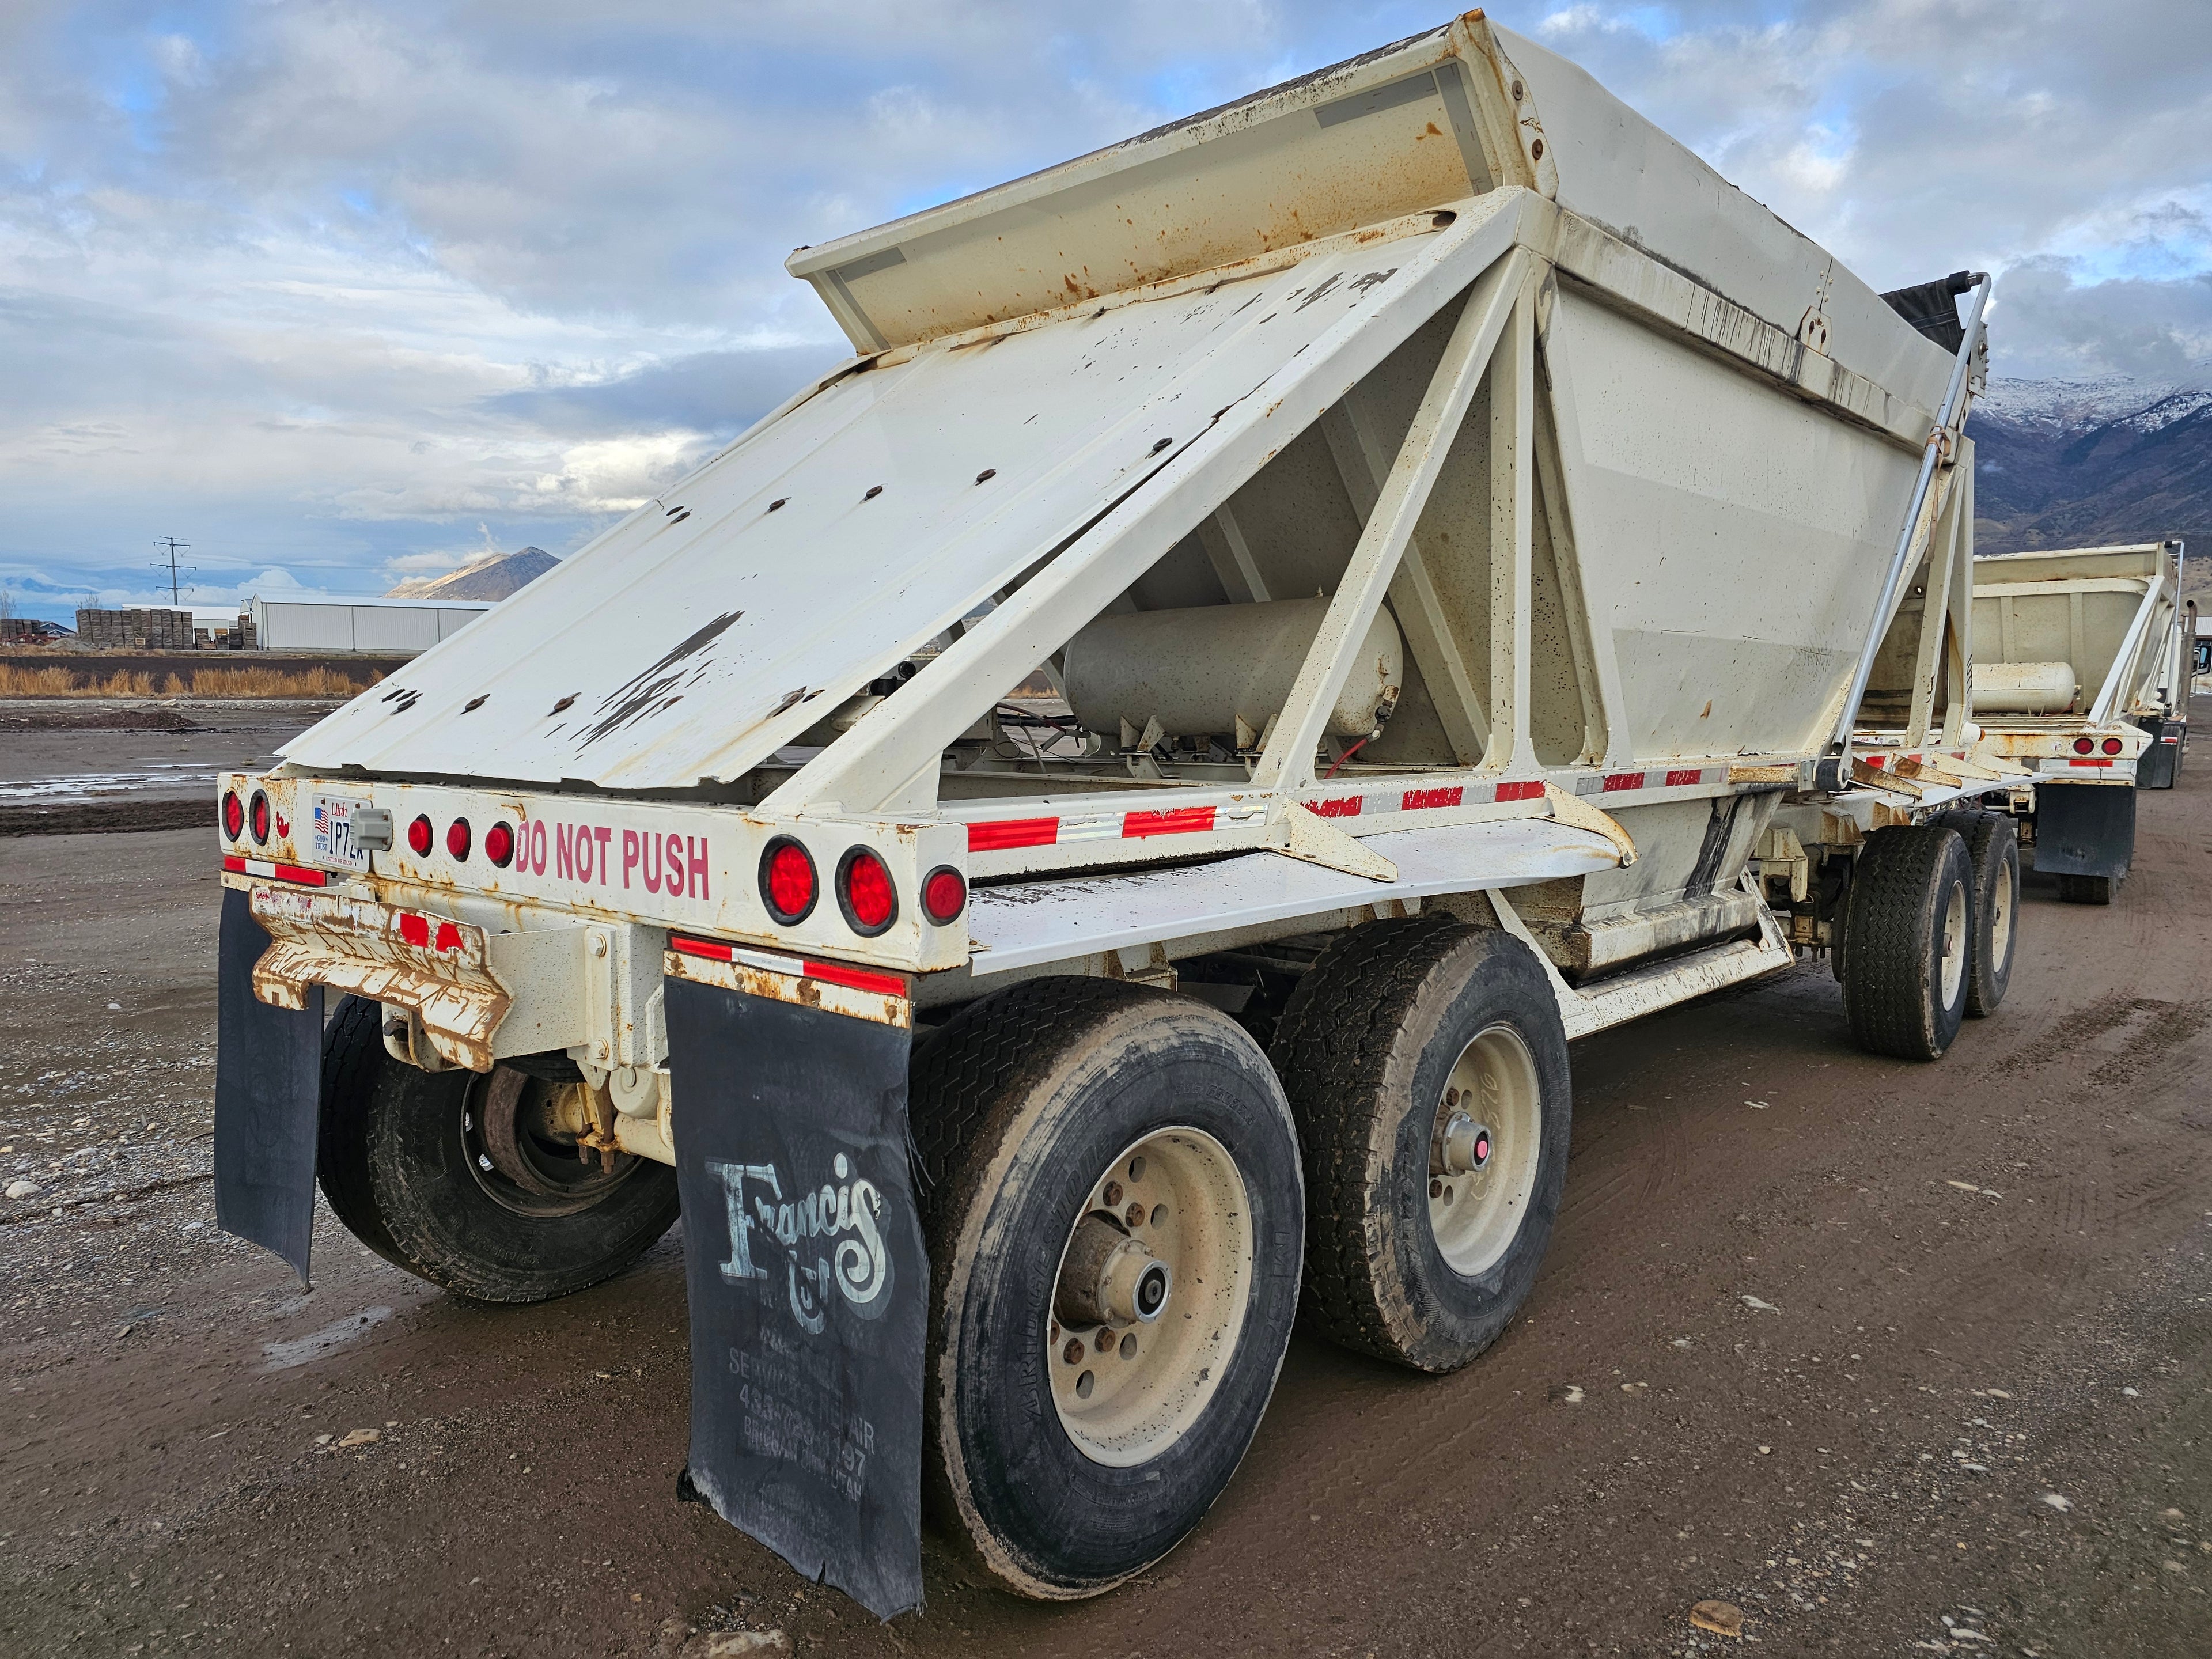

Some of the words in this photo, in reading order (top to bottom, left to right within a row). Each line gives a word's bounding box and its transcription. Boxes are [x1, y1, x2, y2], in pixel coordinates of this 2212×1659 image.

[331, 802, 347, 818] Utah
[315, 842, 327, 851] TRUST
[516, 819, 547, 877] DO
[556, 822, 612, 887] NOT
[623, 829, 710, 901] PUSH
[704, 1152, 887, 1304] Francis
